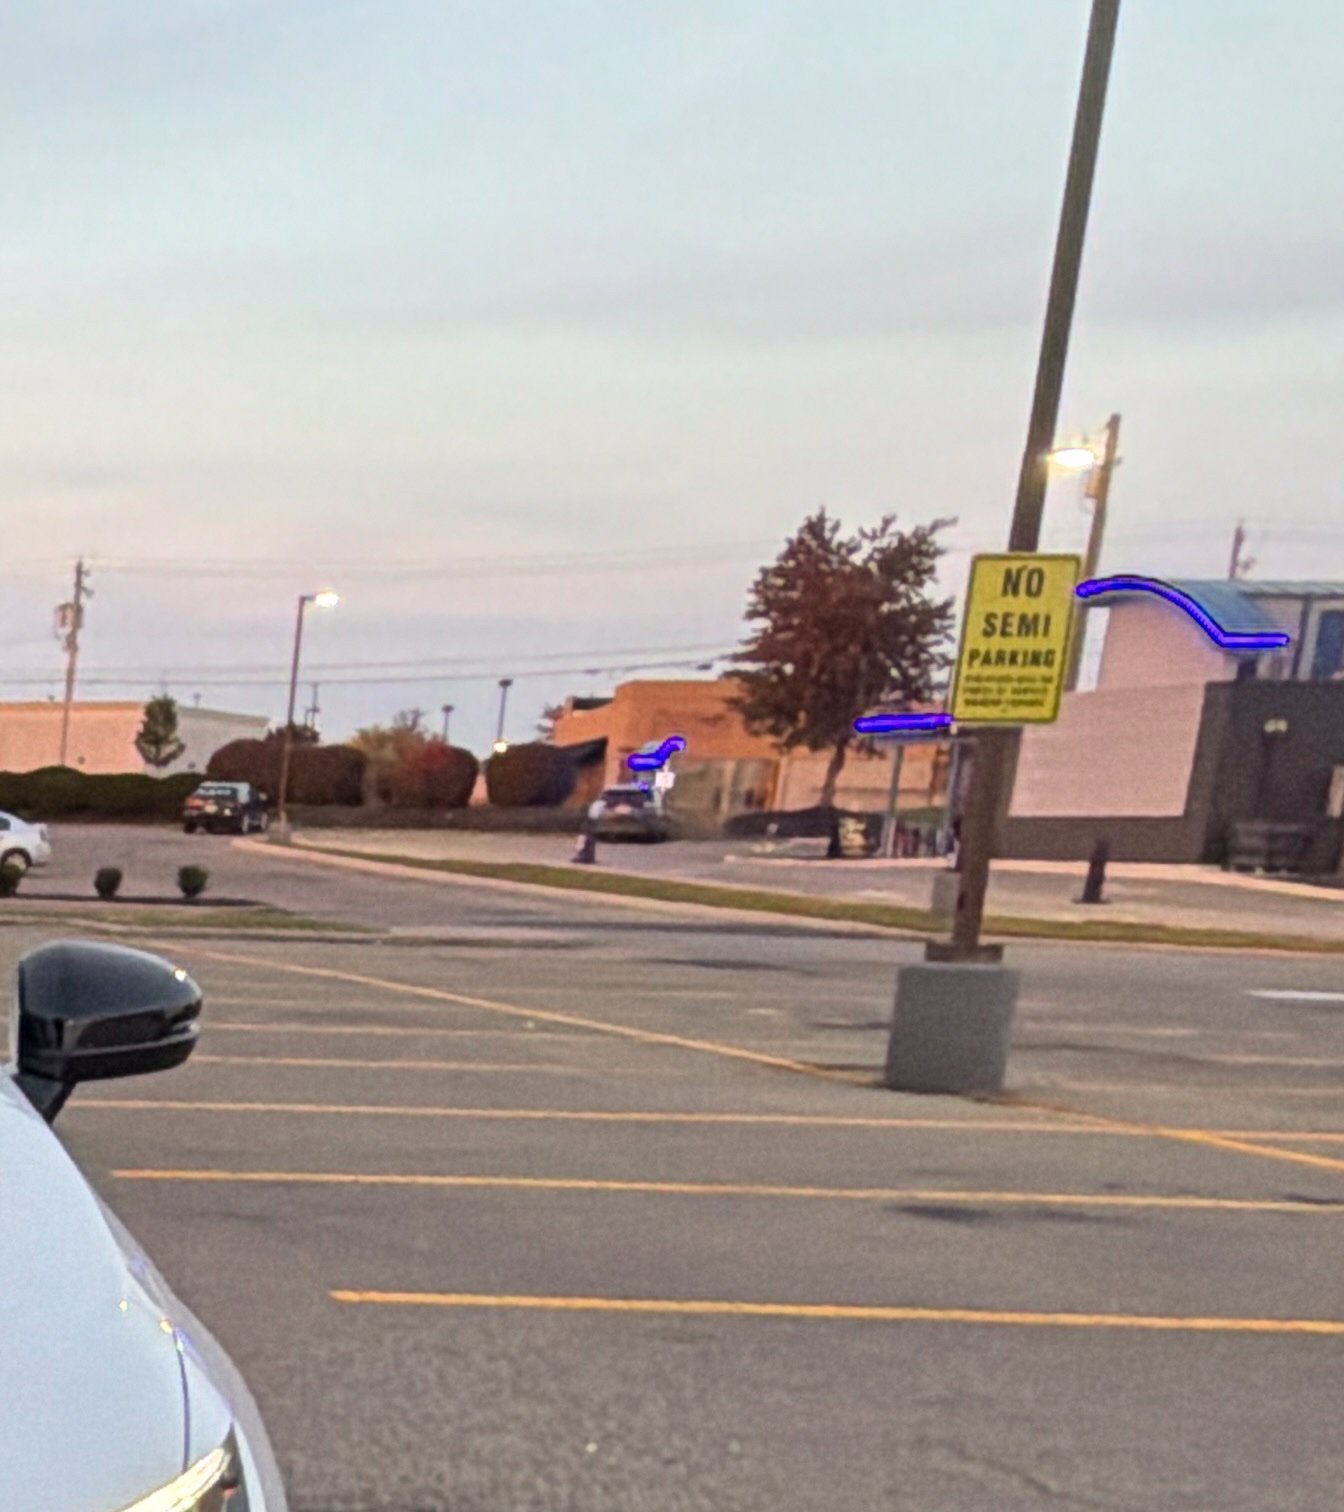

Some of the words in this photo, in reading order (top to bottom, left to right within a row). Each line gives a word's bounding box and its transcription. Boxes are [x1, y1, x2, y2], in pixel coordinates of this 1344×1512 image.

[1002, 568, 1045, 597] NO
[983, 613, 1051, 637] SEMI
[968, 649, 1056, 668] PARKING
